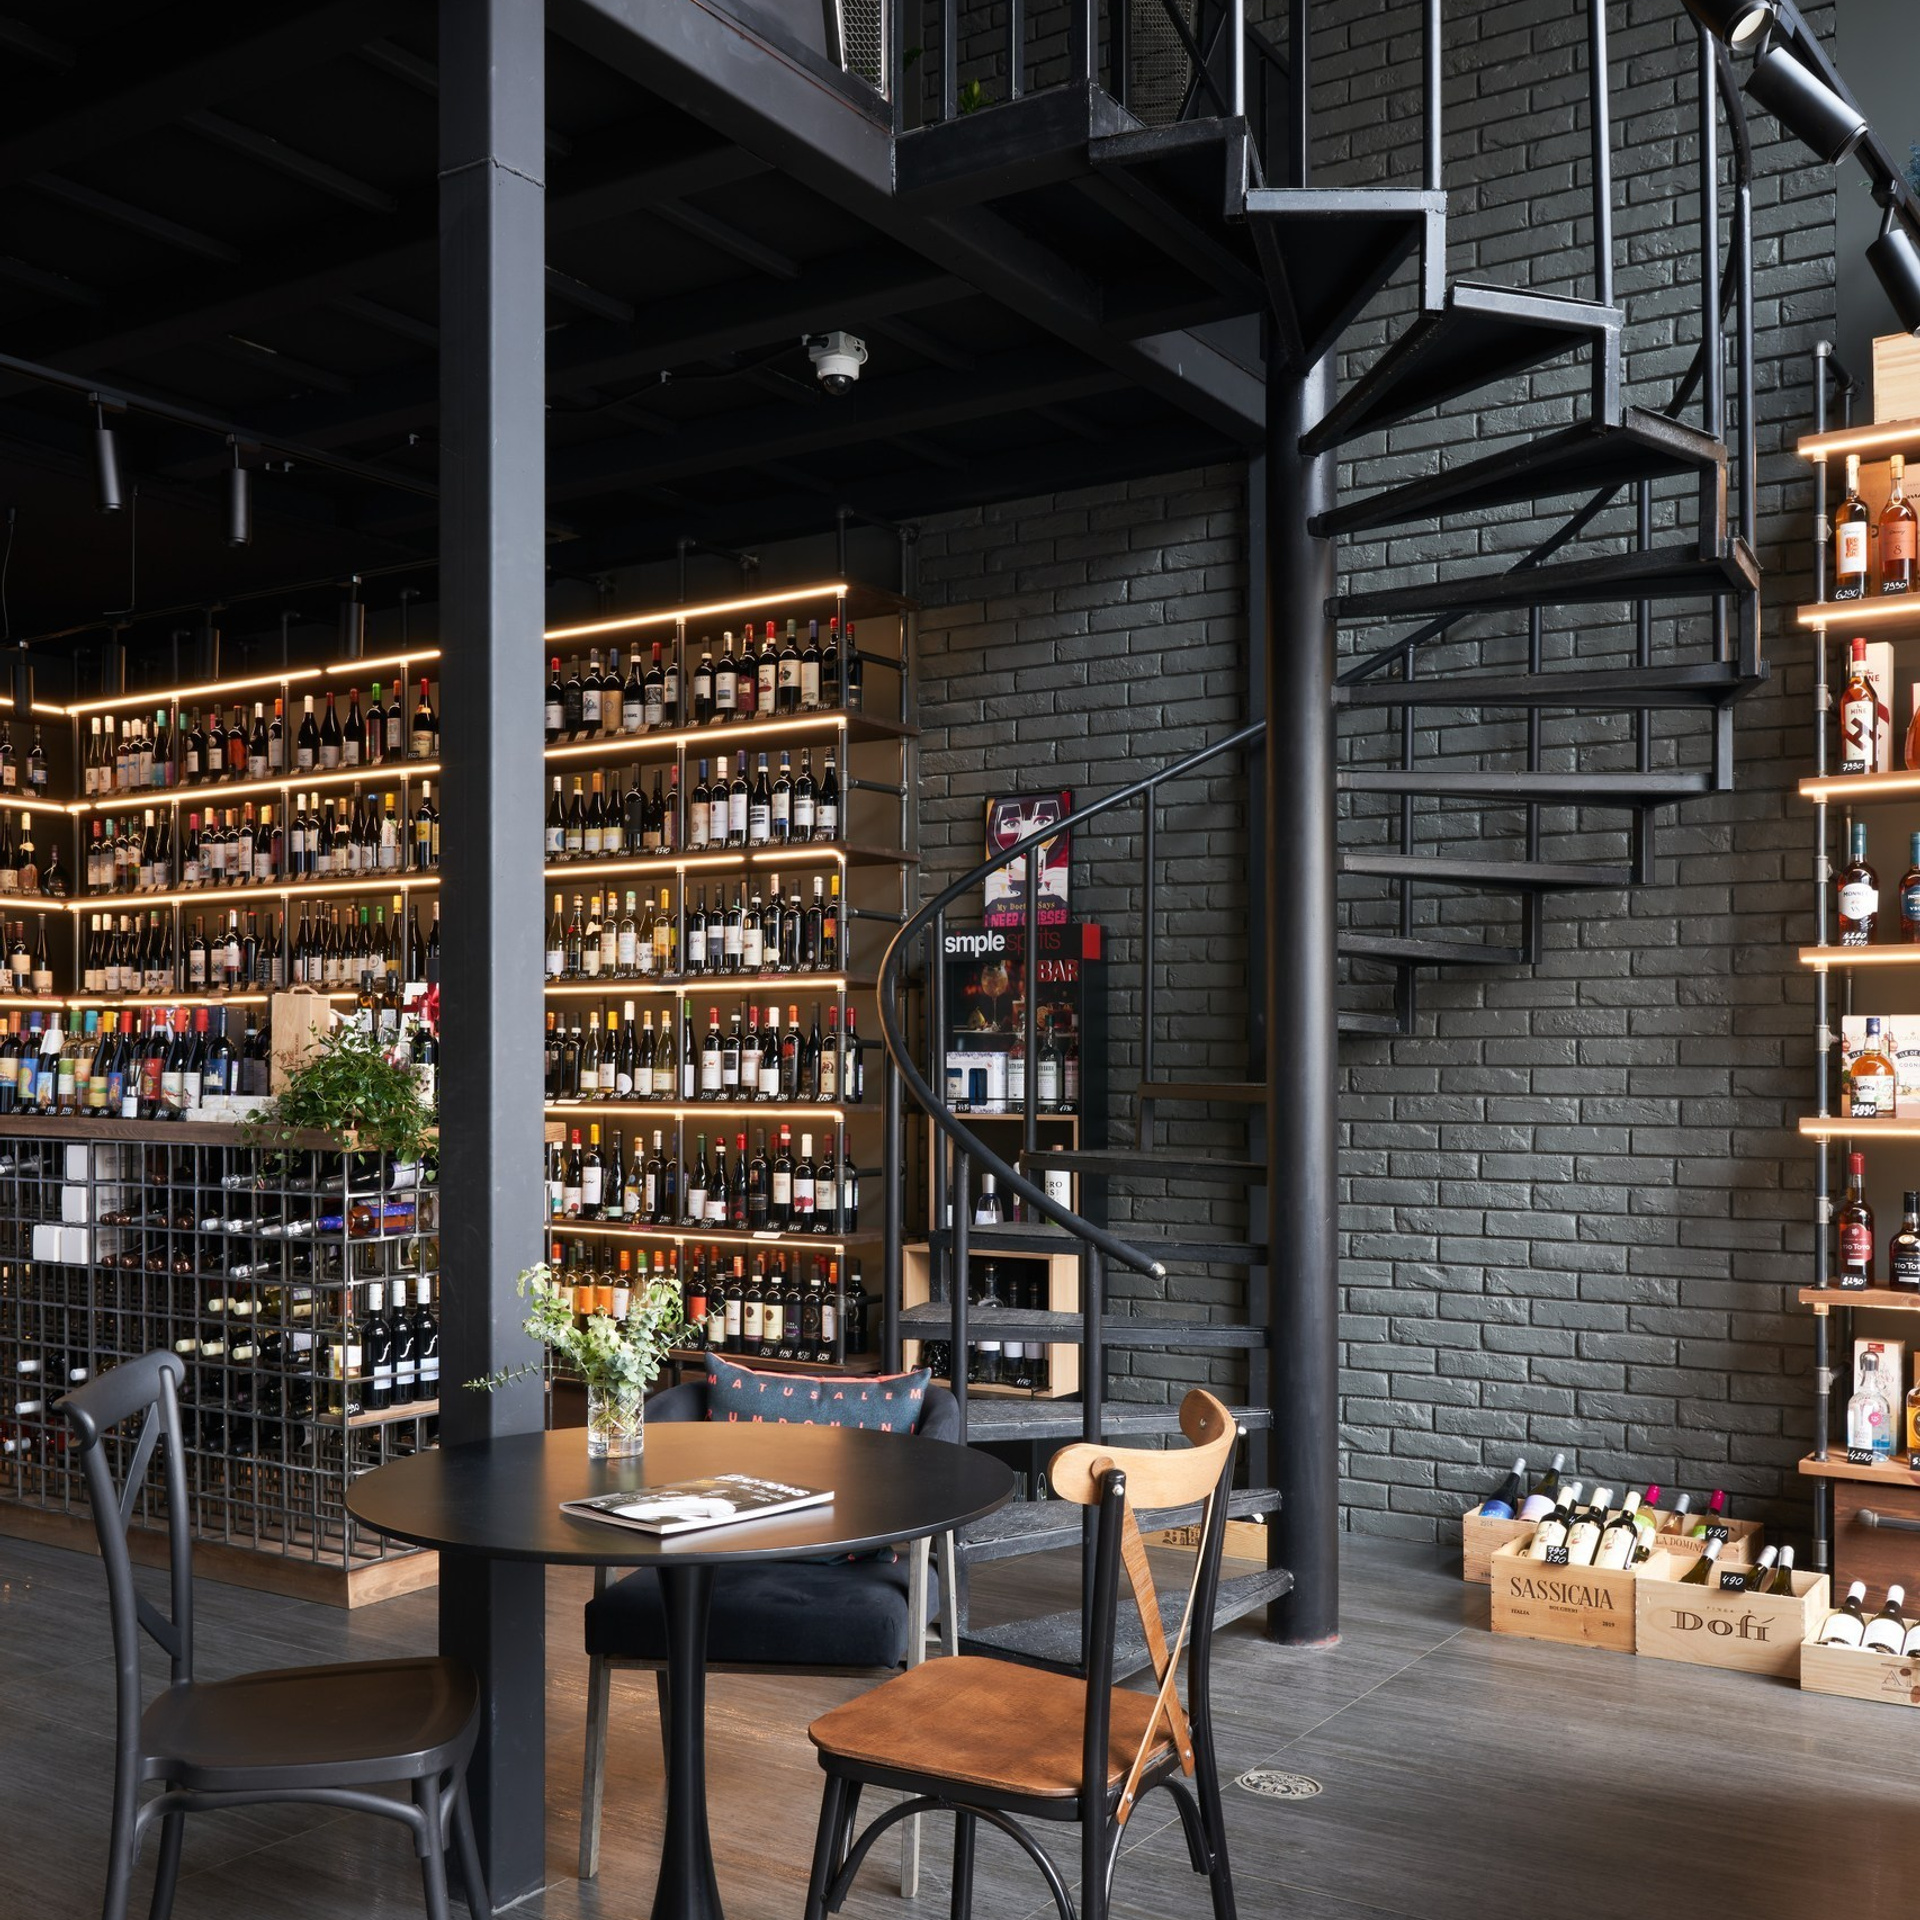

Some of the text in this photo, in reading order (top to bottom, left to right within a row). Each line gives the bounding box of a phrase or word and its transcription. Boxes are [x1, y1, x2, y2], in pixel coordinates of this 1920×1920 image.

[1893, 545, 1902, 555] 8
[1835, 589, 1859, 600] 6290
[1842, 763, 1864, 772] 7990
[996, 903, 1007, 912] My
[1037, 901, 1056, 911] Says
[990, 912, 1019, 928] NEED
[945, 930, 1006, 958] simple
[1037, 960, 1079, 982] BAR
[1851, 1104, 1876, 1117] 7990
[707, 1374, 922, 1400] MATUSALEM
[1707, 1527, 1728, 1538] 490
[1546, 1554, 1567, 1564] 590
[1722, 1575, 1744, 1586] 490
[1510, 1576, 1615, 1610] SASSICAIA
[1511, 1608, 1530, 1616] ITALIA
[1670, 1609, 1776, 1643] Dofí
